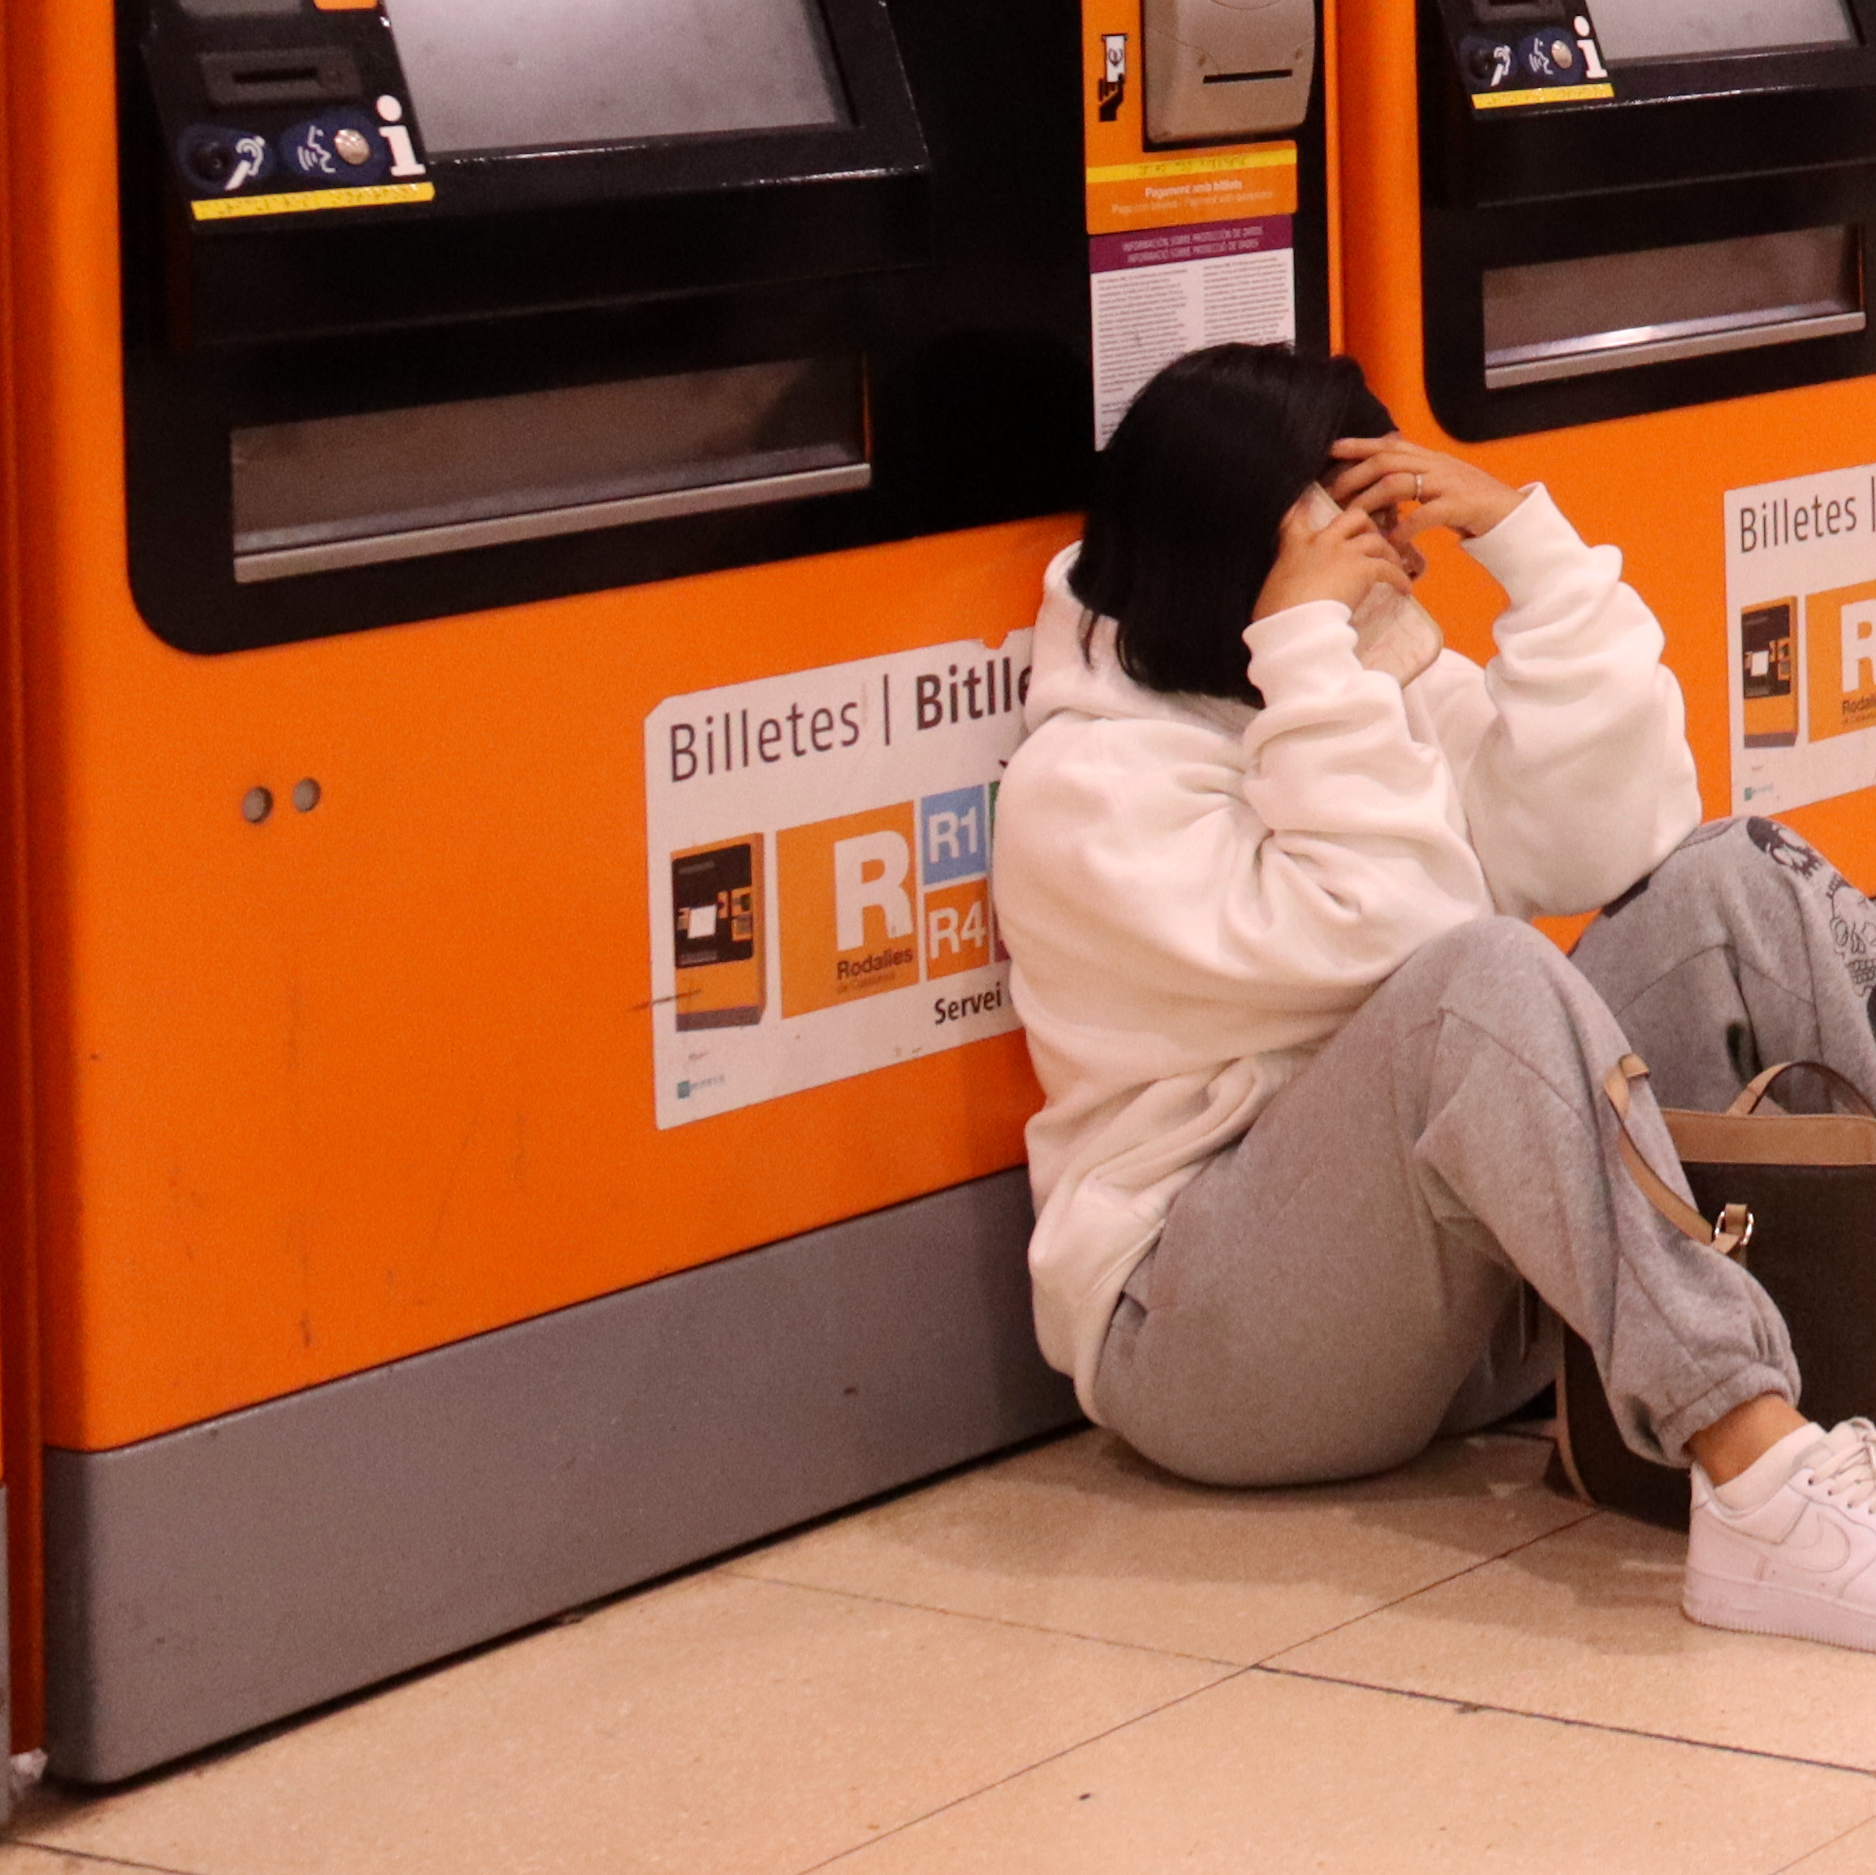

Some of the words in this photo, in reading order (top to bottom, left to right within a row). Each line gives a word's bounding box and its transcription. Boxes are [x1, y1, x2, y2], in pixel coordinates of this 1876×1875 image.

[1739, 494, 1858, 553] Billetes
[671, 702, 859, 783] Billetes
[929, 807, 978, 864] R1
[834, 830, 914, 952] R
[929, 900, 988, 959] R4
[837, 947, 913, 980] Rodalies
[934, 981, 1002, 1025] Servei
